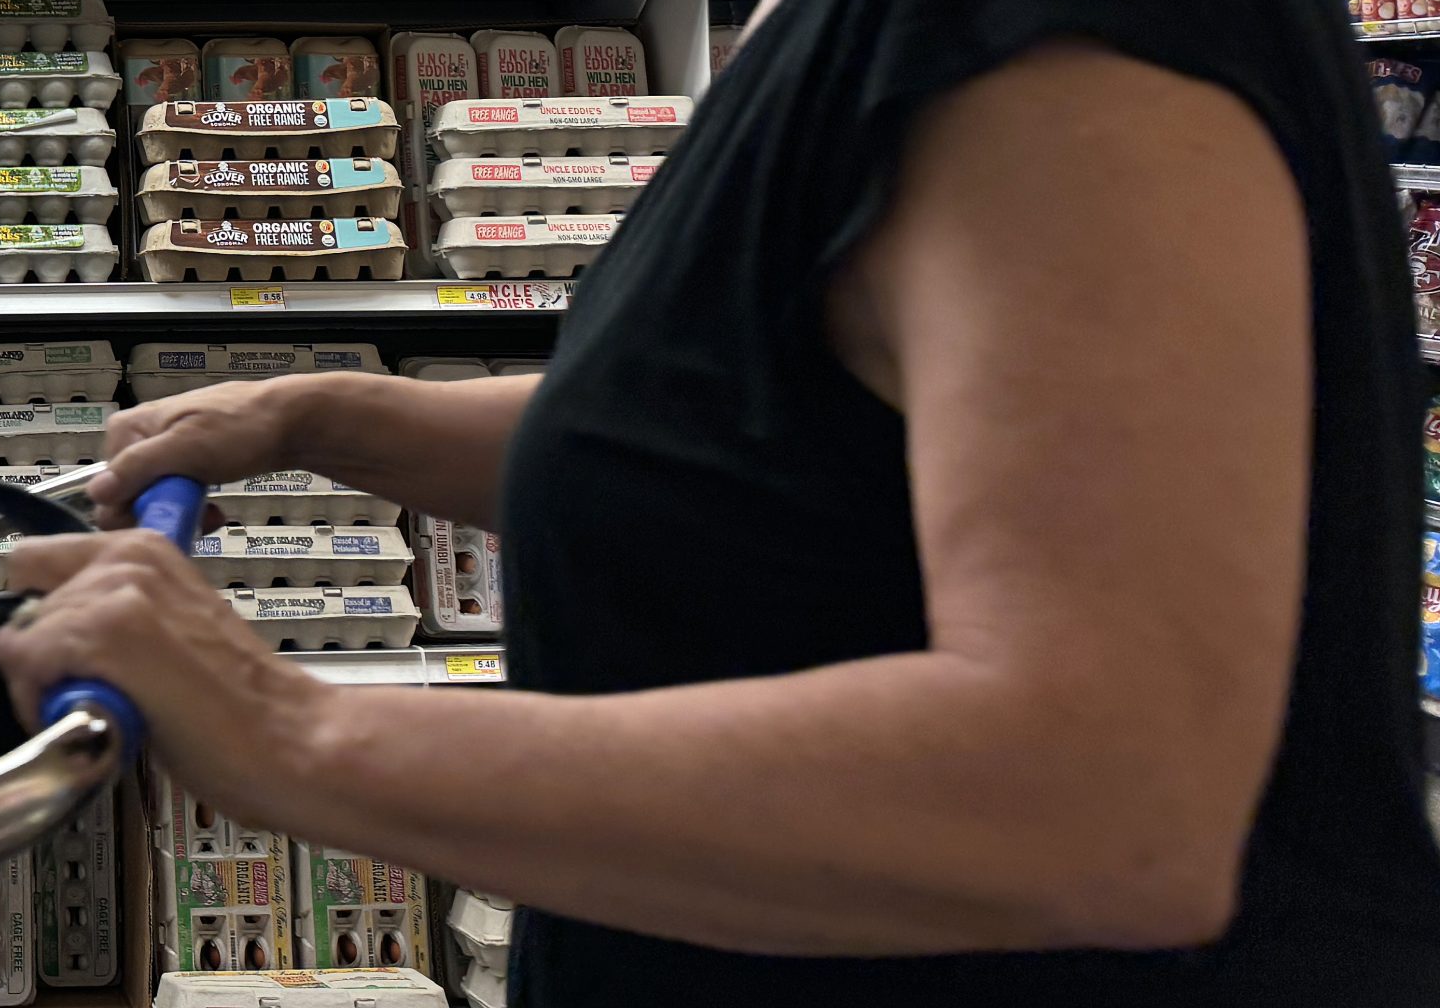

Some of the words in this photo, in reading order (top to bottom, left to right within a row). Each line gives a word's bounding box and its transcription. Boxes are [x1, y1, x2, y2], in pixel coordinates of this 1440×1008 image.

[419, 80, 445, 90] WILD
[448, 79, 468, 90] HEN
[246, 103, 305, 114] ORGANIC
[568, 107, 602, 115] EDDIE'S
[201, 112, 242, 124] CLOVER
[248, 115, 271, 126] FREE
[274, 113, 305, 125] RANGE
[471, 110, 490, 121] FREE
[491, 109, 516, 121] RANGE
[249, 162, 308, 173] ORGANIC
[474, 168, 492, 178] FREE
[494, 167, 520, 178] RANGE
[204, 173, 244, 185] CLOVER
[251, 174, 275, 185] FREE
[277, 172, 309, 185] RANGE
[253, 223, 312, 233] ORGANIC
[207, 233, 248, 244] CLOVER
[255, 235, 278, 245] FREE
[281, 233, 313, 245] RANGE
[489, 284, 532, 297] NCLE
[437, 533, 448, 564] JUMBO
[237, 861, 249, 905] ORGANIC
[12, 913, 23, 941] CAGE
[14, 945, 23, 972] FREE
